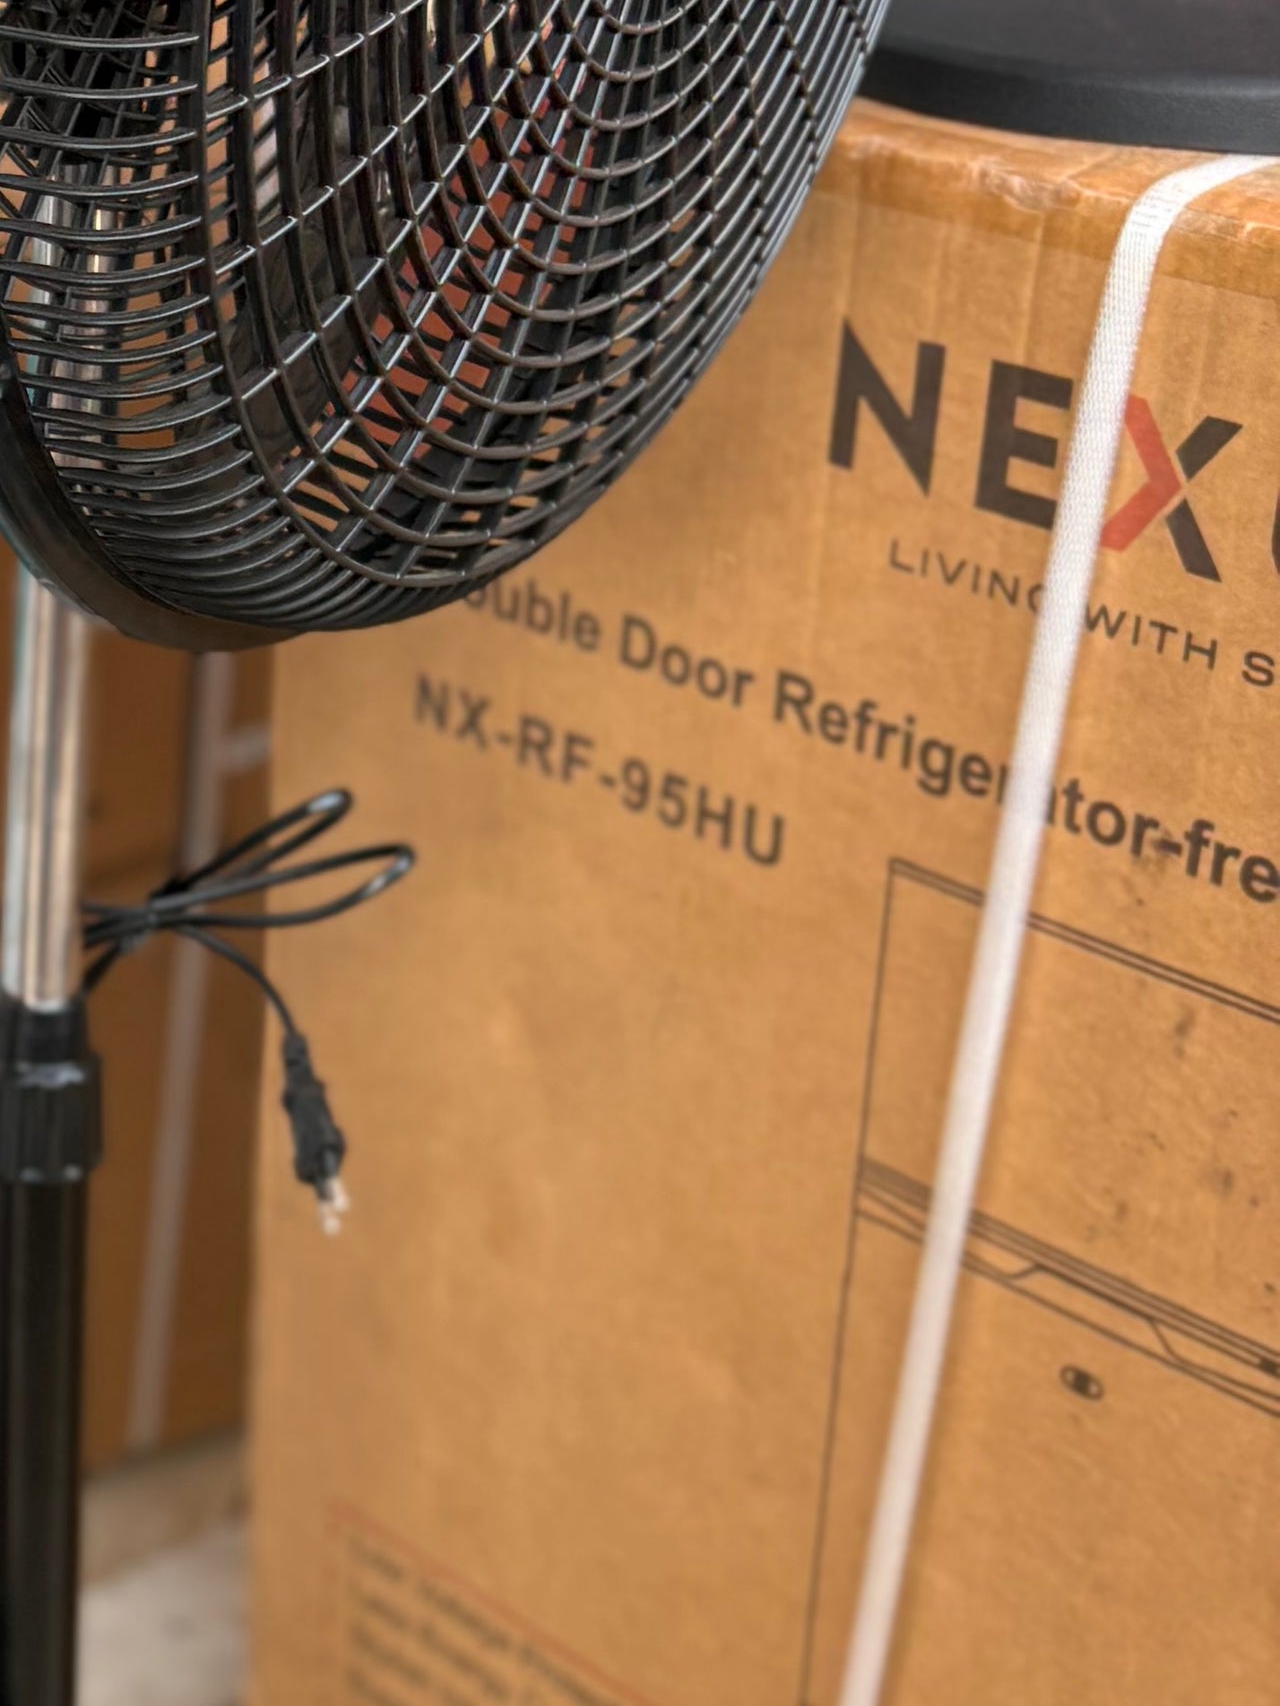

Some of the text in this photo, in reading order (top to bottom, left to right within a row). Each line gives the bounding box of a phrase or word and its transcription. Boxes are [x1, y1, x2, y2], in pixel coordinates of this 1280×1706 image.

[828, 315, 1280, 584] NEX
[458, 575, 603, 654] ouble
[619, 615, 755, 708] Door
[1084, 604, 1218, 671] WITH
[414, 676, 785, 869] NX-RF-95HU
